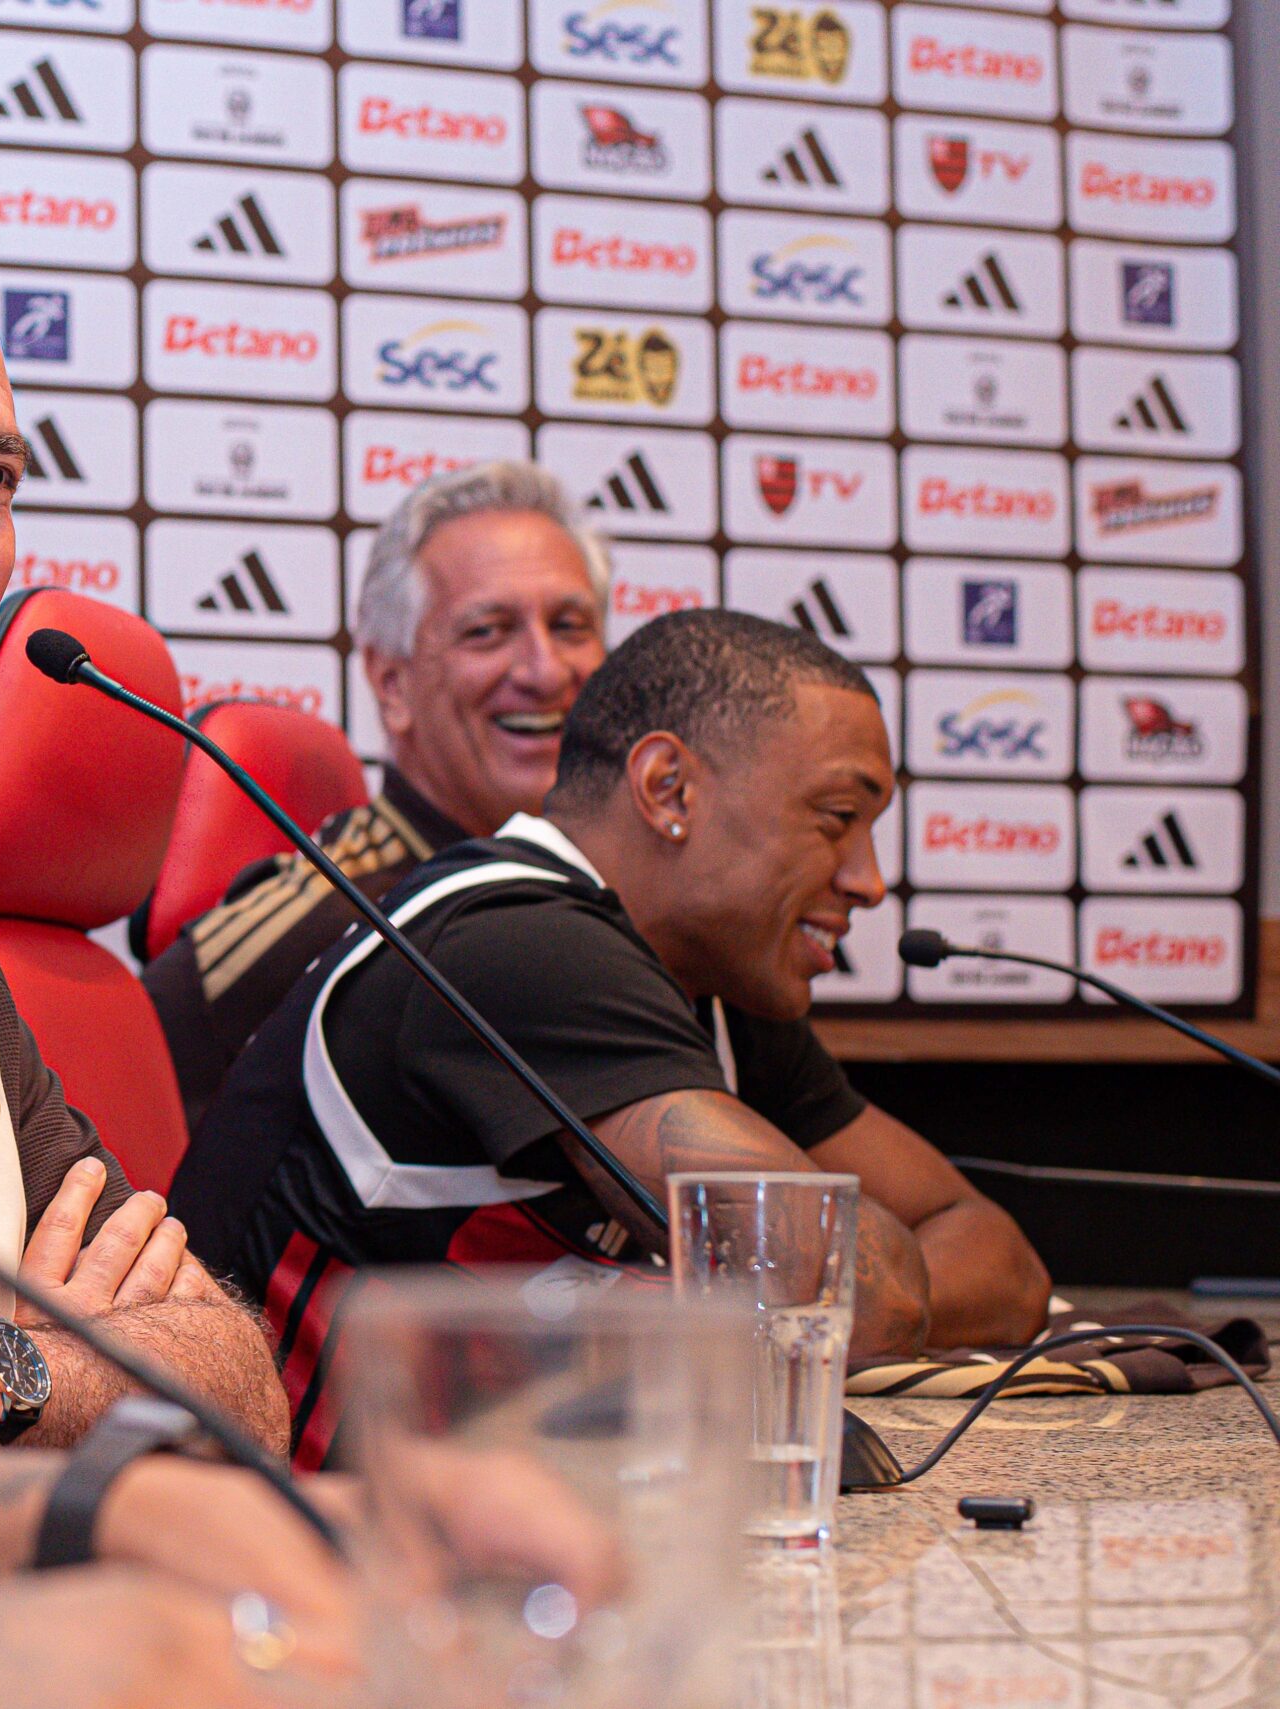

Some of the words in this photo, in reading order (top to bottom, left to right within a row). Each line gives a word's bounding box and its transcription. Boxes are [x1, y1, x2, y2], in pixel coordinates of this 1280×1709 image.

[563, 13, 678, 65] Sesc
[909, 38, 1044, 84] Betano
[358, 97, 507, 145] Betano
[978, 152, 1030, 182] TV
[1080, 163, 1215, 206] Betano
[551, 229, 697, 276] Betano
[753, 254, 862, 303] Sesc
[163, 315, 319, 363] Betano
[377, 341, 498, 391] Sesc
[737, 355, 879, 400] Betano
[807, 471, 862, 502] TV
[918, 478, 1057, 521] Betano
[1091, 599, 1227, 644] Betano
[938, 713, 1044, 760] Sesc
[923, 812, 1062, 855] Betano
[1093, 927, 1227, 970] Betano
